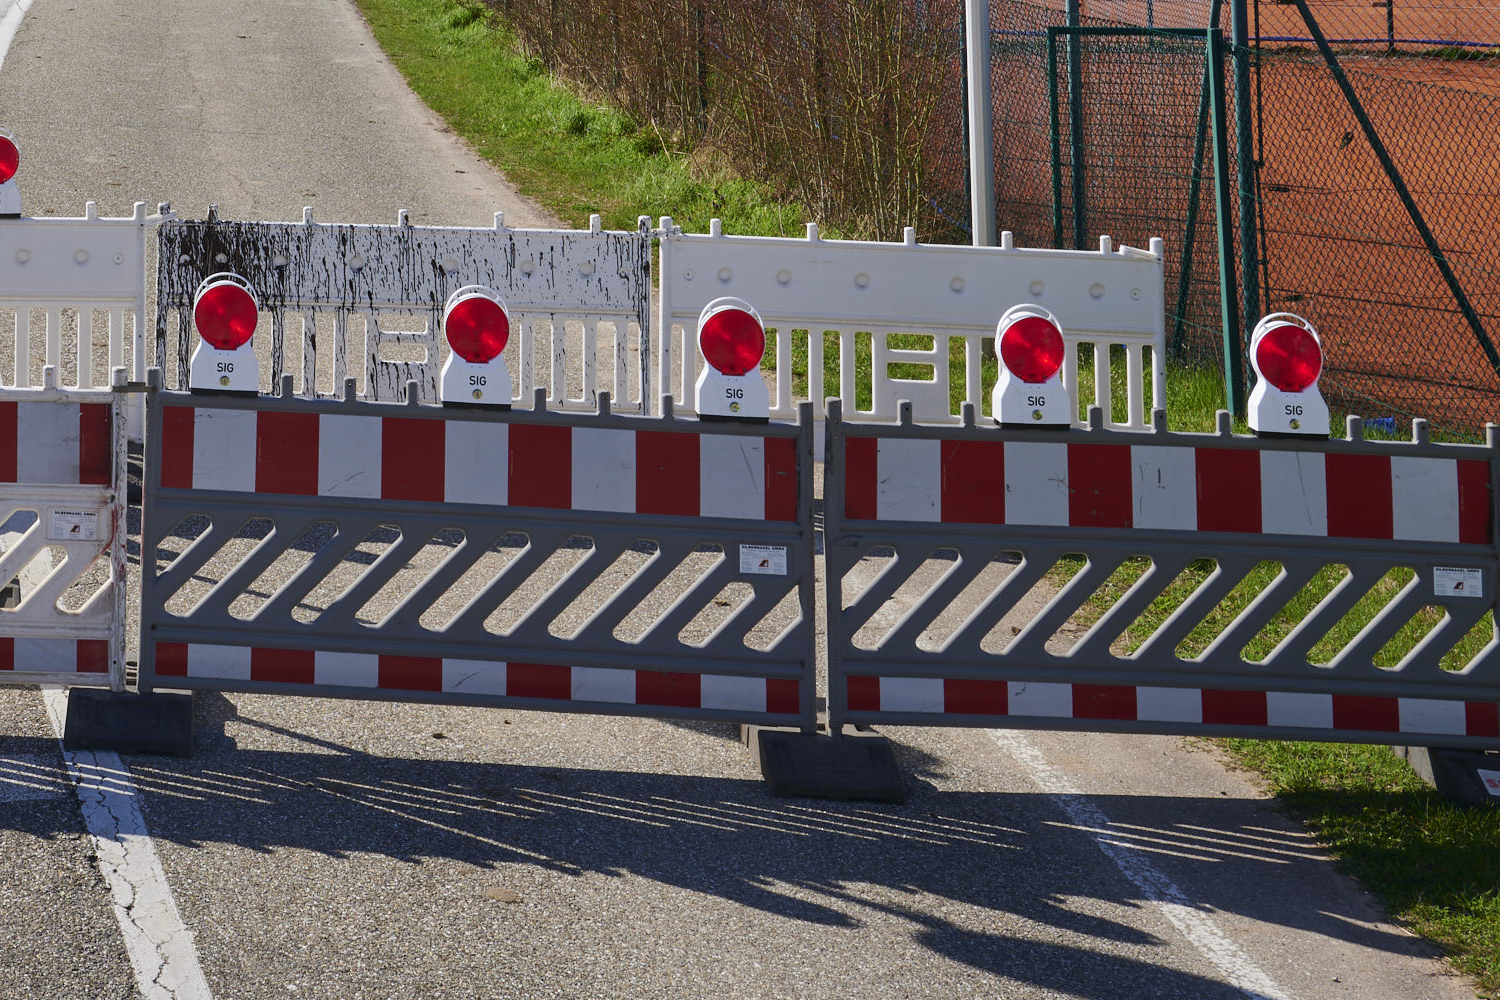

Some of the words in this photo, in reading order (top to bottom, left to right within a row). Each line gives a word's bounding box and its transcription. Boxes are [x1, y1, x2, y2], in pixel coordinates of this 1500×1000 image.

[216, 362, 234, 373] SIG
[469, 375, 487, 386] SIG
[725, 388, 744, 399] SIG
[1027, 396, 1045, 407] SIG
[1285, 405, 1303, 416] SIG
